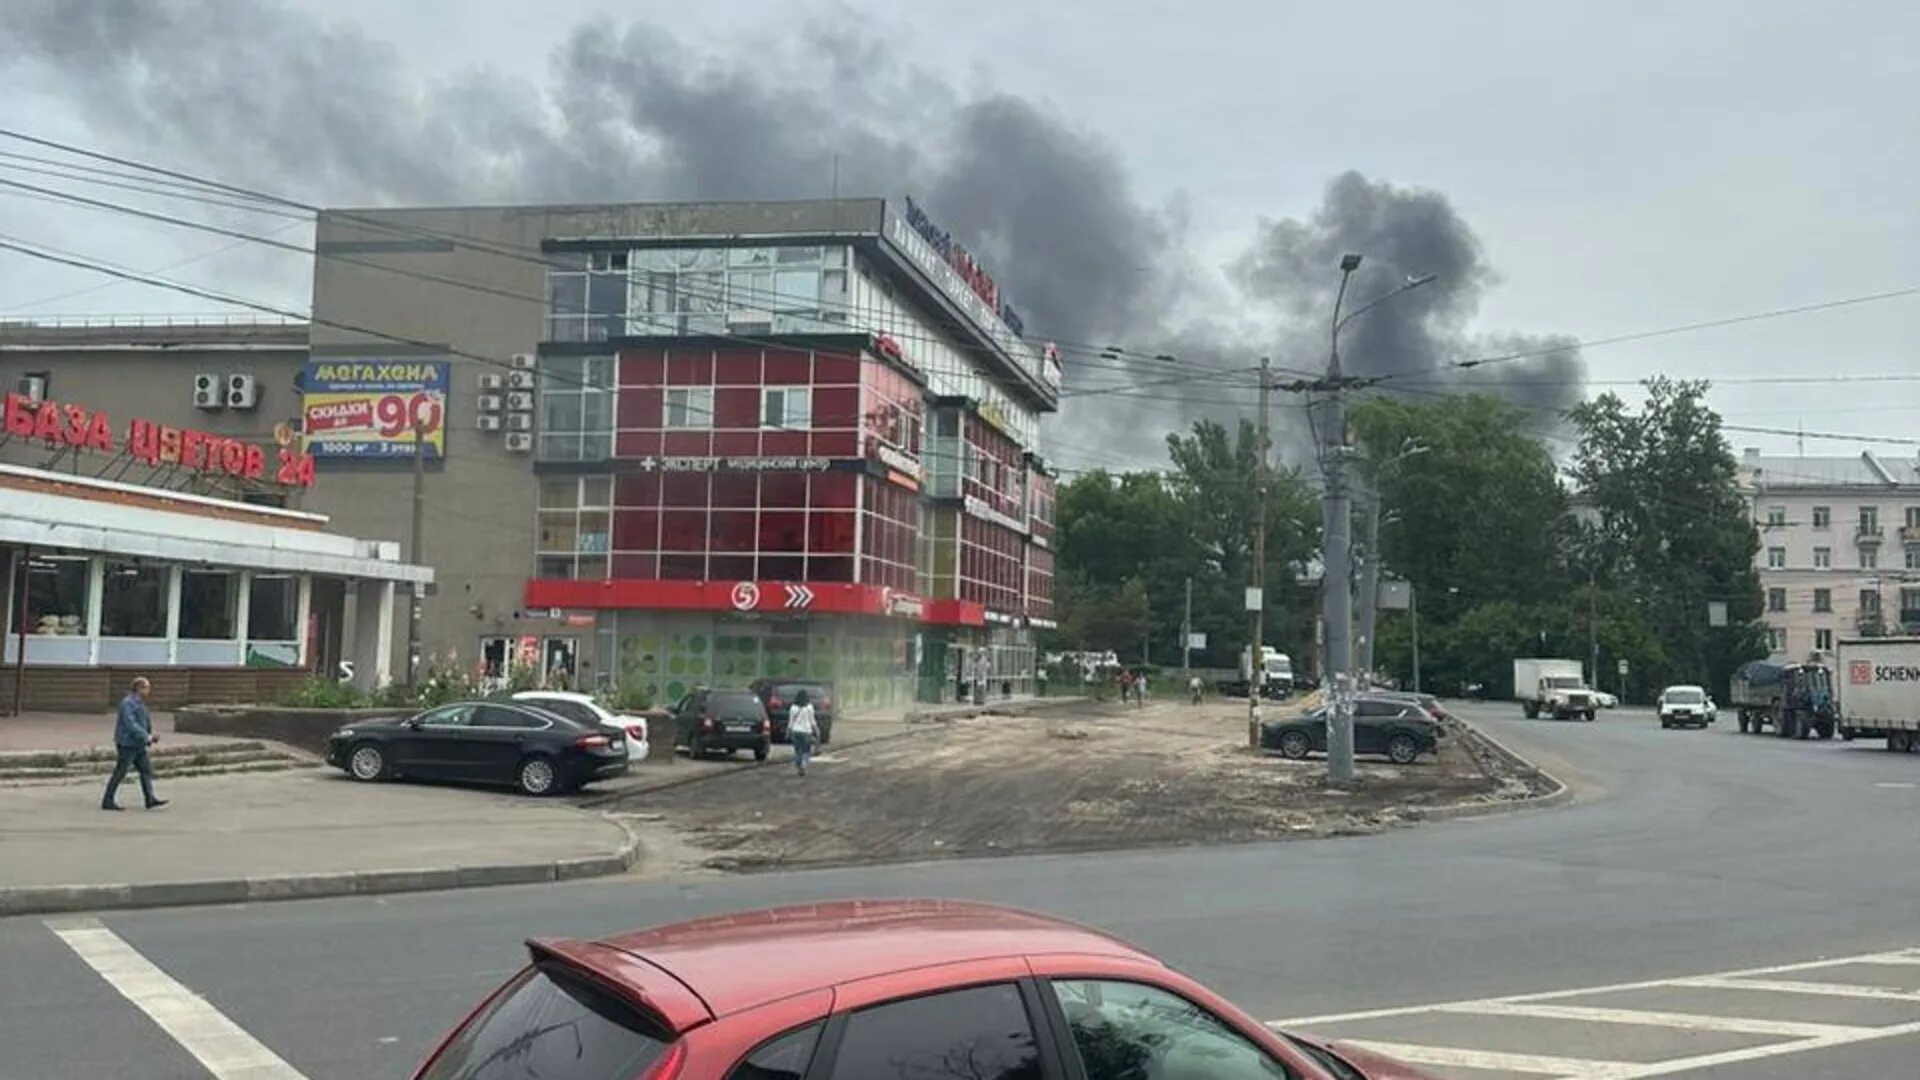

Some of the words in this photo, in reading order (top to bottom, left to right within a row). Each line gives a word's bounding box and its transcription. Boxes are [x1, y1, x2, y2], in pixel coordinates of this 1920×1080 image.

[311, 403, 368, 418] СКИДКИ
[377, 394, 440, 437] 90
[5, 392, 113, 451] БАЗА
[131, 418, 264, 479] ЦВЕТОВ
[276, 448, 315, 488] 24
